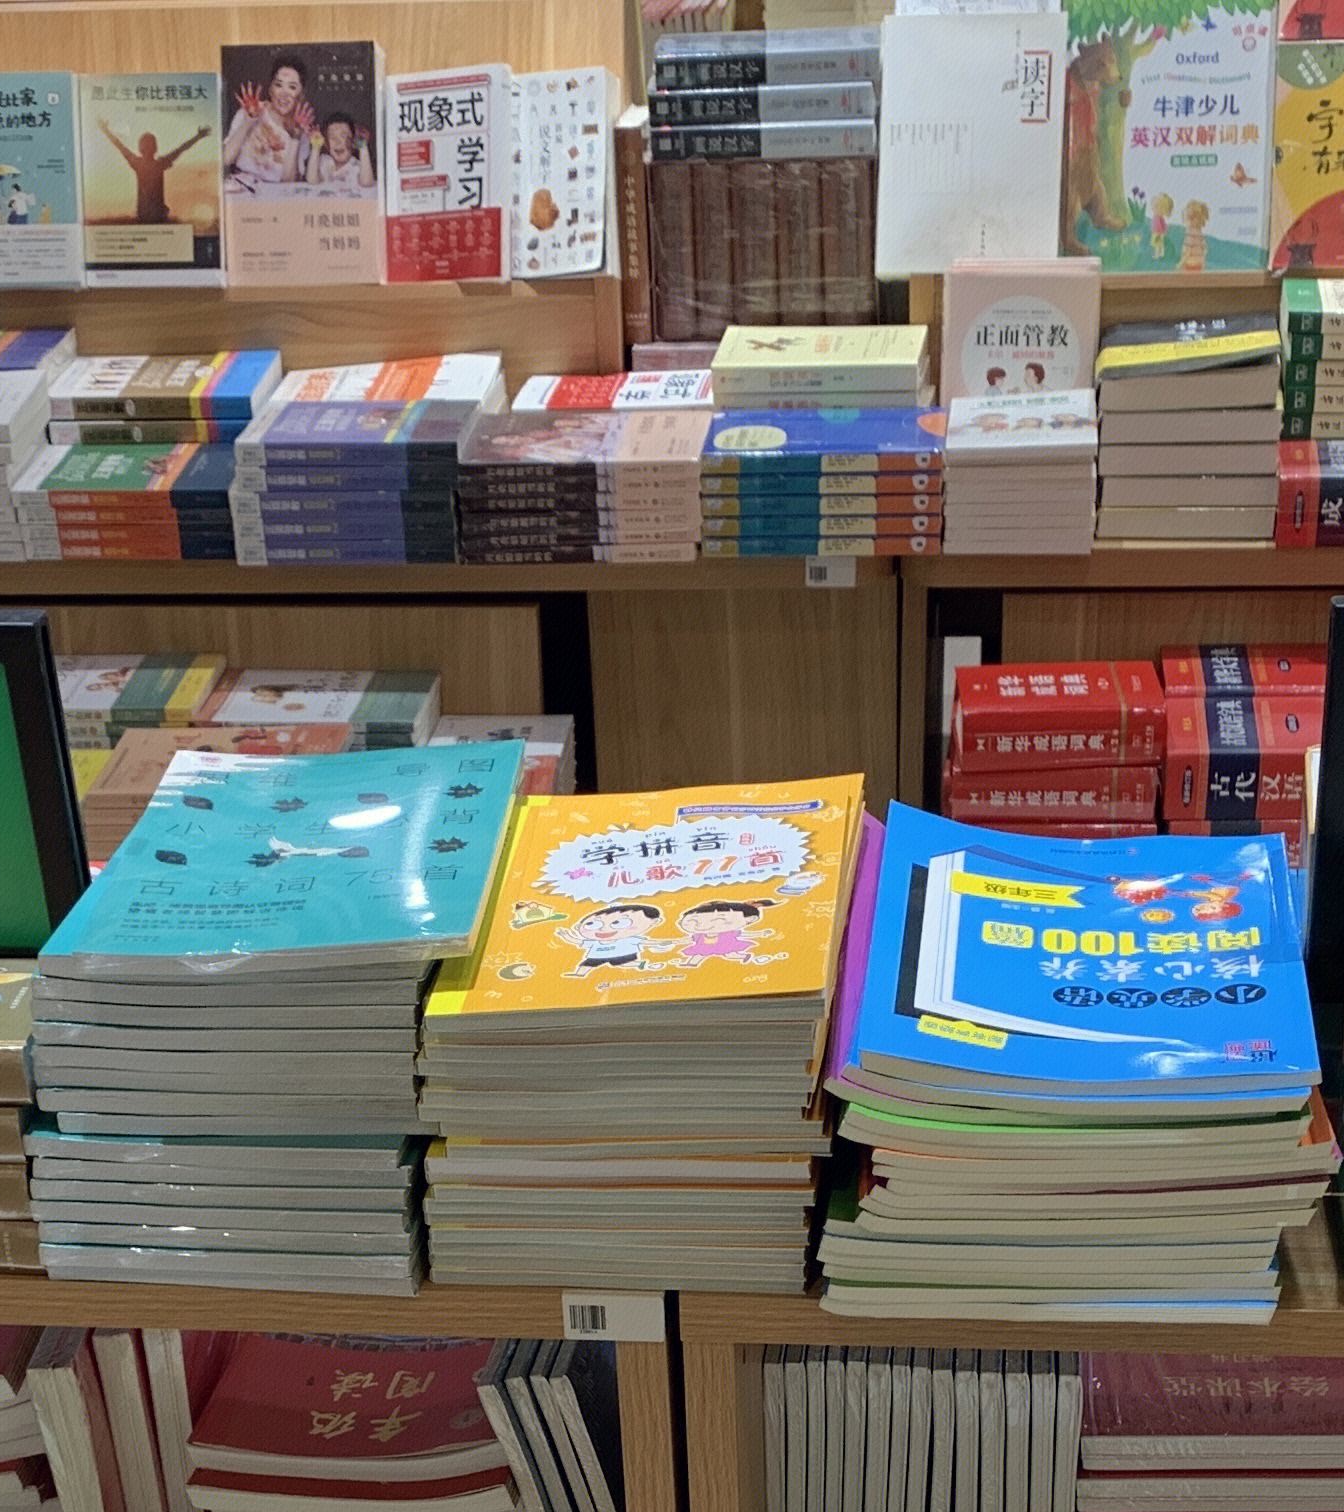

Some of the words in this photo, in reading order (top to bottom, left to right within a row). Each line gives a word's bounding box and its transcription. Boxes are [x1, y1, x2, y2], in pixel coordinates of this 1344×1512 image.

[1175, 51, 1219, 65] Oxford
[1020, 57, 1045, 117] 读字
[398, 91, 484, 134] 现象式
[1153, 94, 1240, 117] 牛津少儿
[1131, 126, 1259, 148] 英汉双解词典
[974, 323, 1070, 348] 正面管教
[580, 832, 731, 866] 学拼音
[1038, 953, 1265, 982] 核心素养
[1052, 983, 1267, 1008] 小学英语
